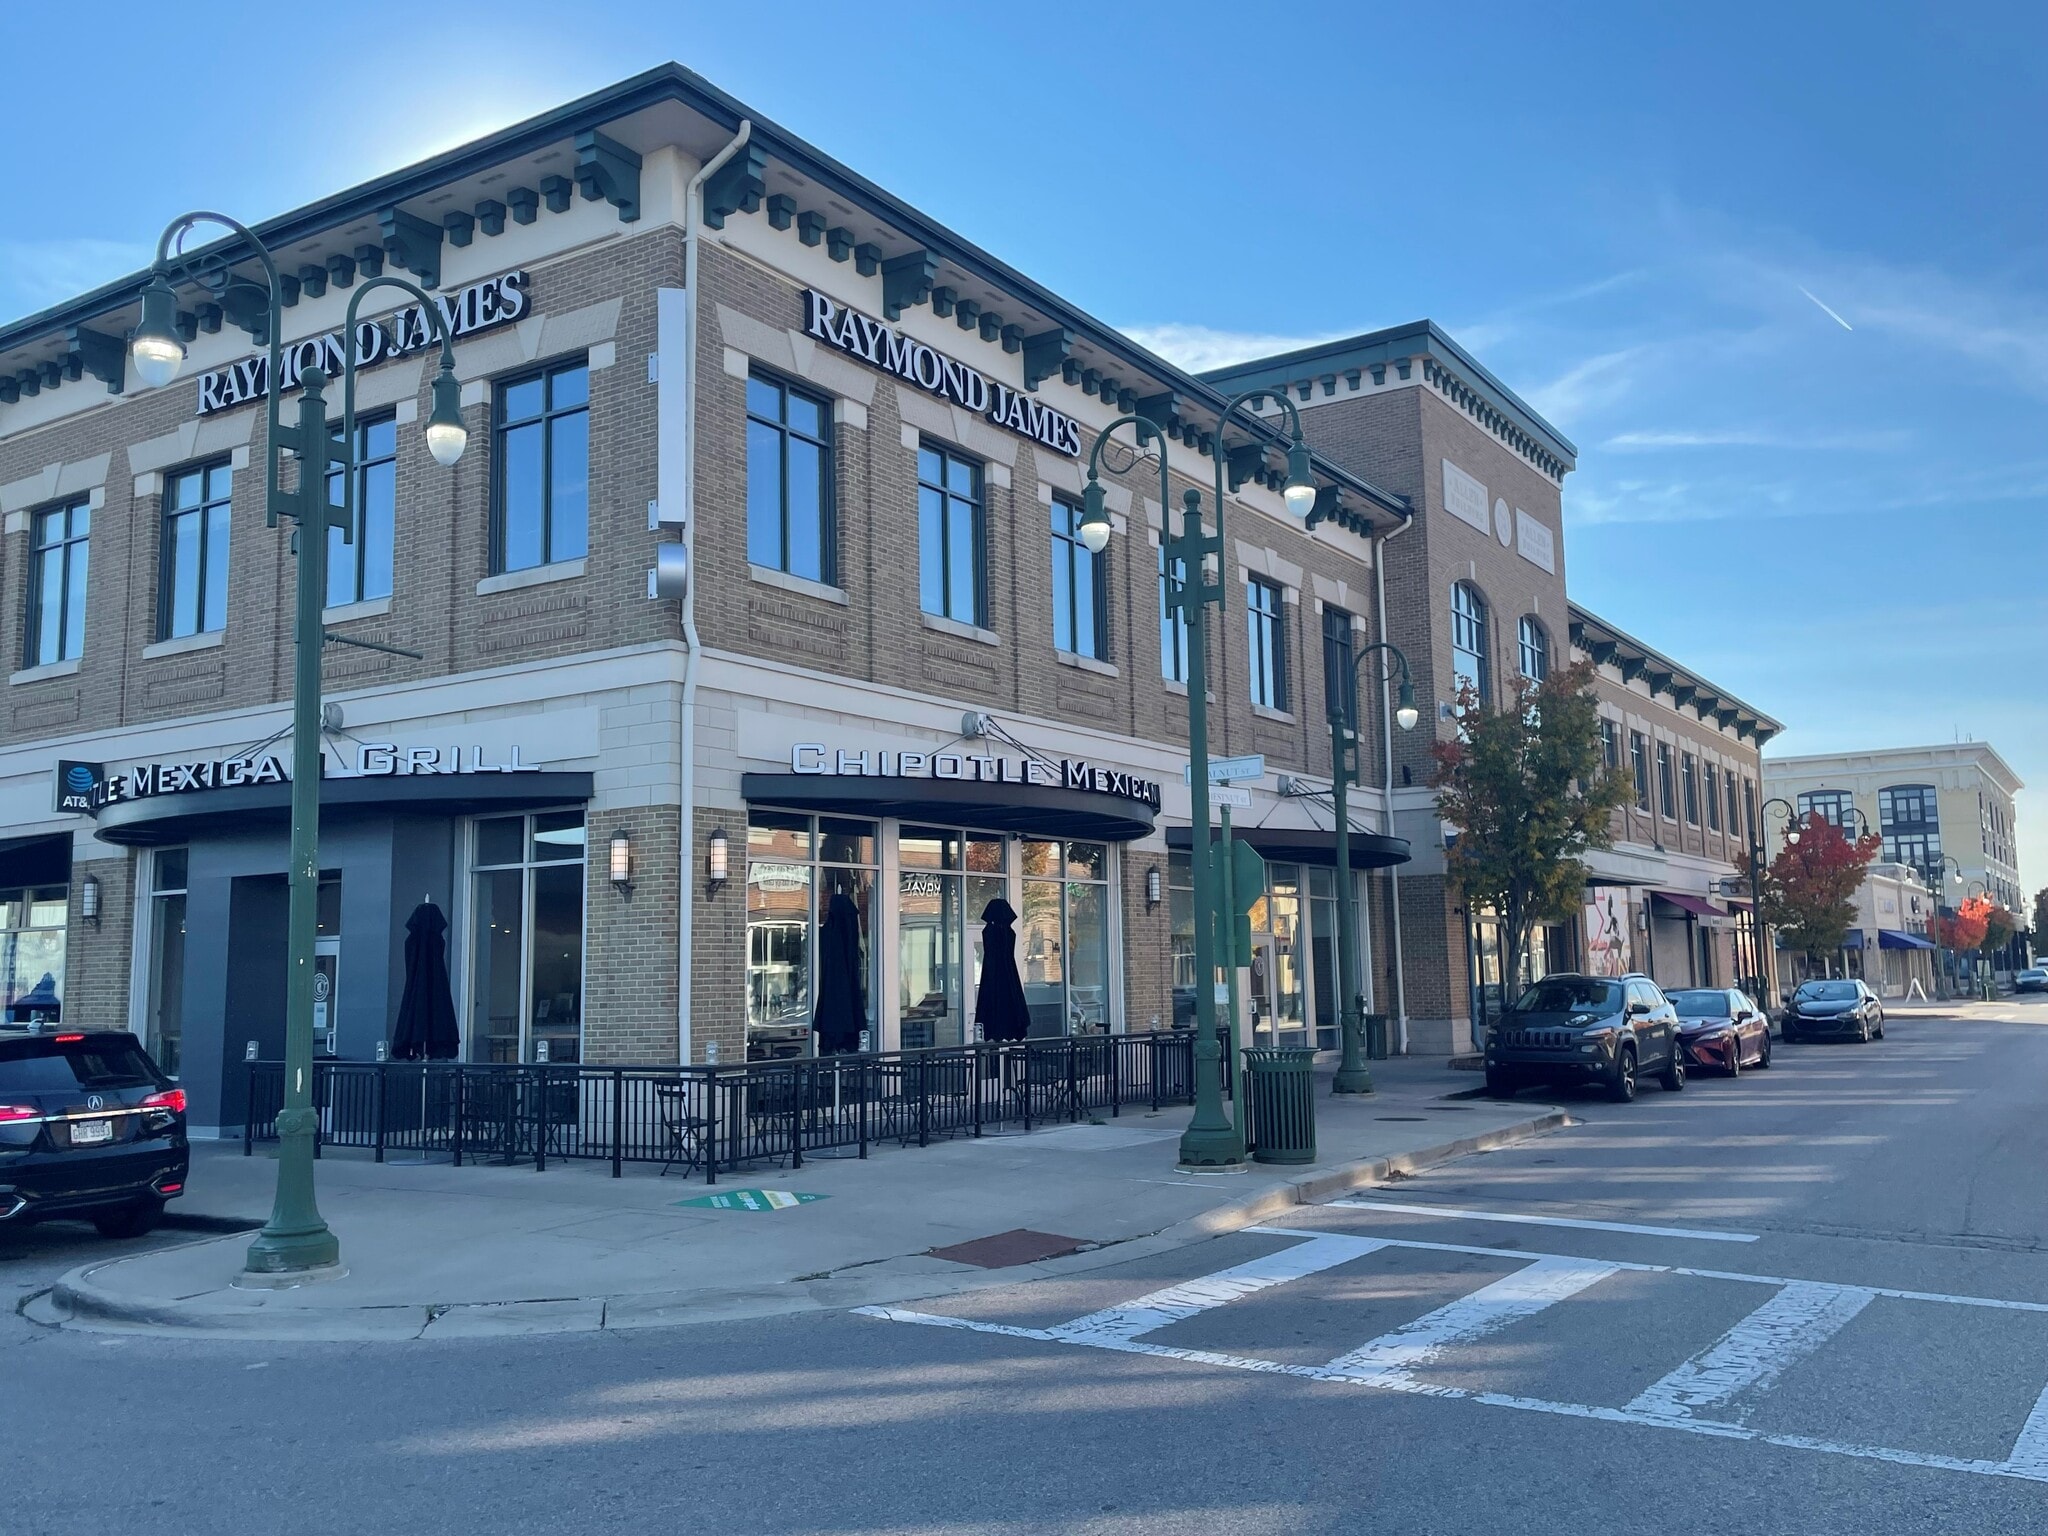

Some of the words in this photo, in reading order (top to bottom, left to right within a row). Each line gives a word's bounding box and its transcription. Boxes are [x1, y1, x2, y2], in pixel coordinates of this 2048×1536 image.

[195, 320, 385, 415] RAYMOND
[387, 270, 528, 357] JAMES
[807, 288, 989, 413] RAYMOND
[992, 383, 1082, 458] JAMES
[132, 755, 298, 797] MEXICA
[356, 743, 541, 776] GRILL
[791, 742, 1047, 784] CHIPOTLE
[1063, 758, 1161, 806] MEXICAN
[1208, 768, 1239, 779] ALNUT
[62, 795, 89, 808] AT&
